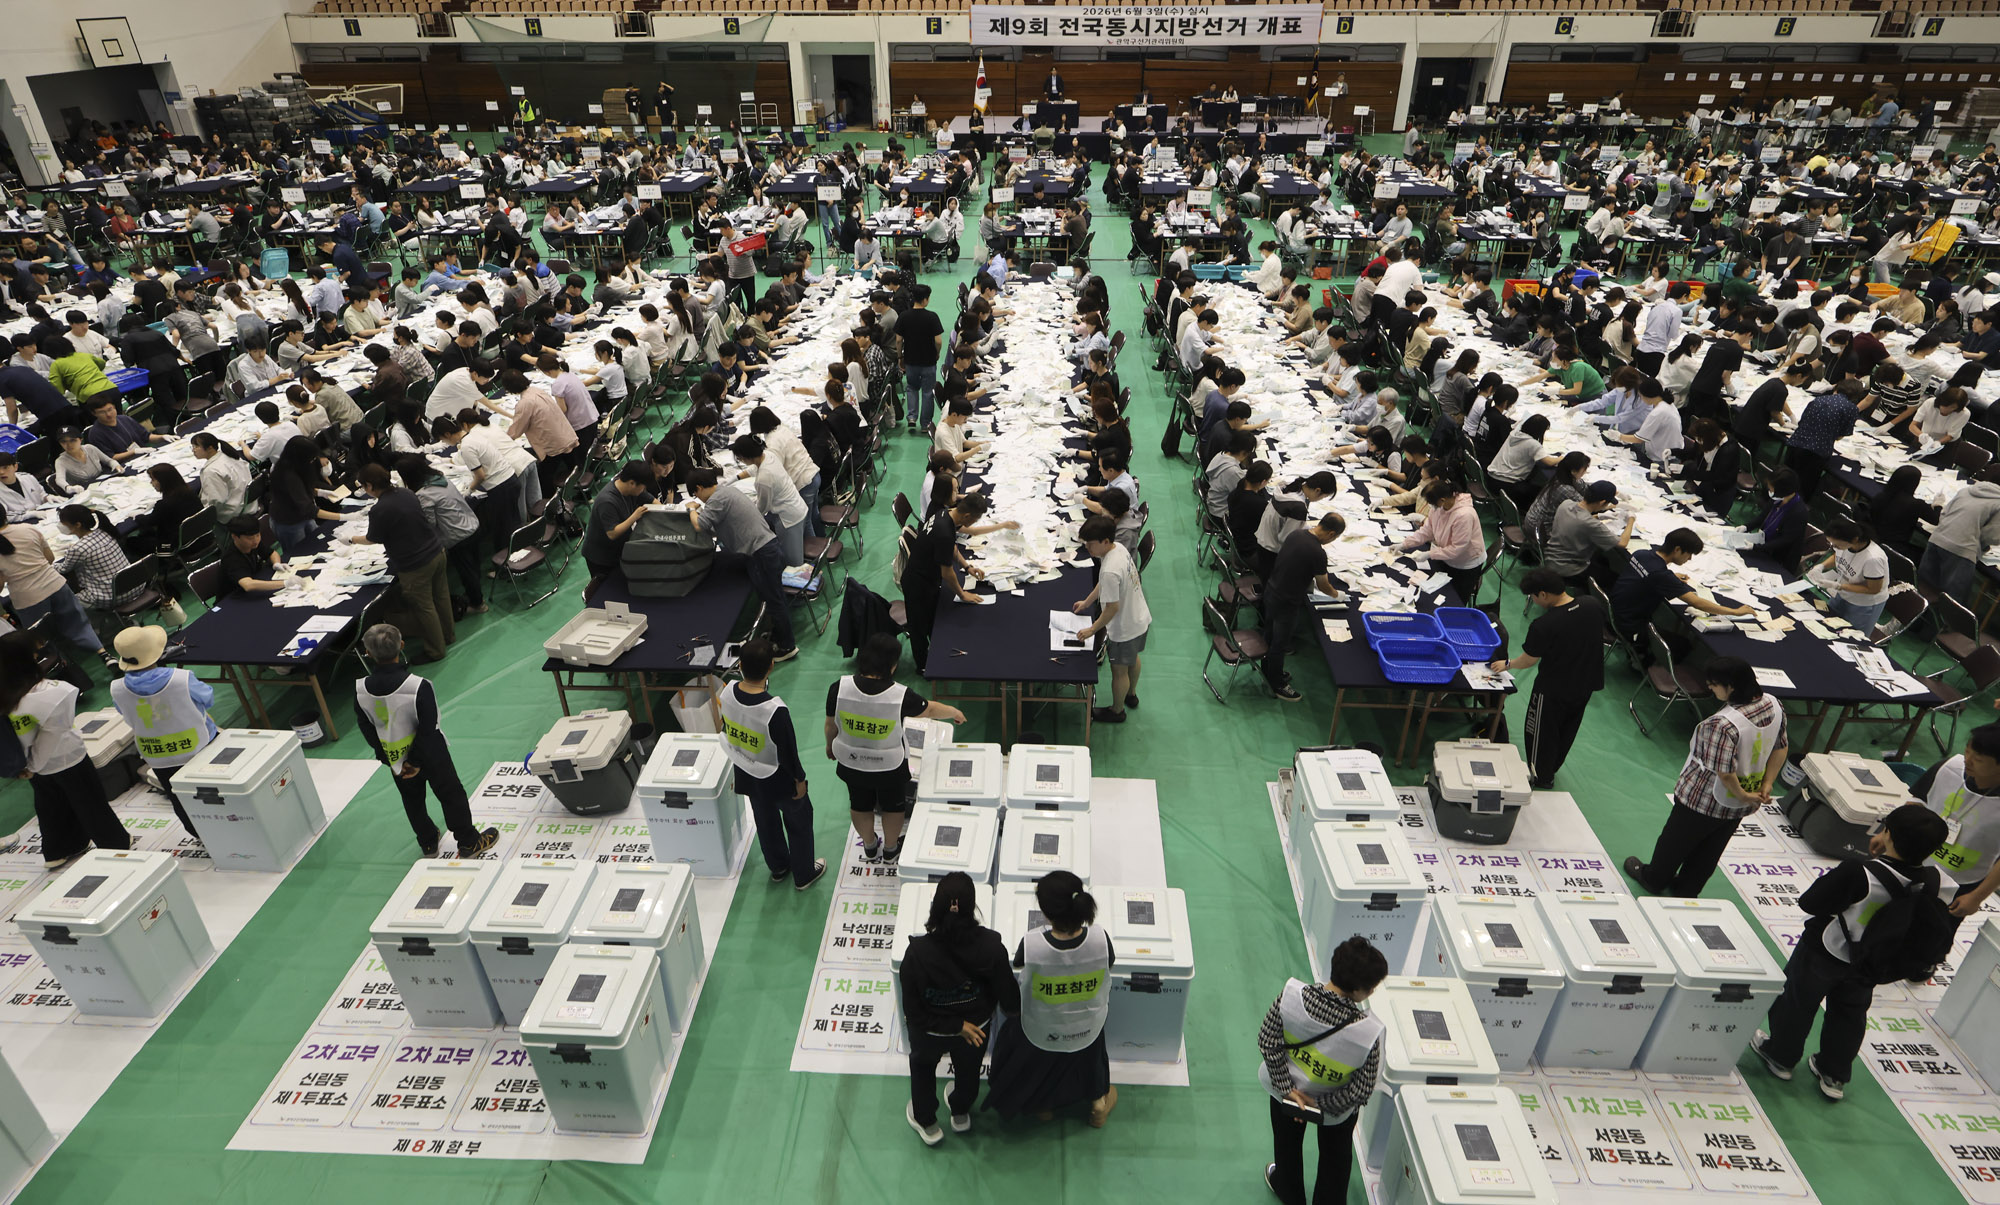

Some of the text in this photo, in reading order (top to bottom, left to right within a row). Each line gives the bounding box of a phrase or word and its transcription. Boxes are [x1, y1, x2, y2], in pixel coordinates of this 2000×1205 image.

[1083, 7, 1209, 16] 2026년 6월 3일(수) 실시
[528, 22, 539, 34] H
[727, 22, 737, 33] G
[931, 22, 937, 33] F
[990, 16, 1302, 36] 제9회 전국동시지방선거 개표
[1340, 21, 1350, 32] D
[1559, 21, 1569, 33] C
[1780, 22, 1790, 34] B
[1926, 22, 1936, 34] A
[845, 718, 888, 734] 개표참관
[142, 738, 192, 755] 개표참관
[496, 766, 536, 776] 관내
[482, 784, 542, 798] 은천동
[536, 824, 593, 835] 1차 교부
[612, 826, 635, 836] 1차
[535, 842, 573, 851] 삼성동
[612, 844, 650, 853] 삼성동
[1456, 855, 1521, 868] 2차 교부
[1934, 844, 1964, 868] 참관
[850, 866, 898, 877] 제1투표
[1538, 858, 1605, 871] 2차 교부
[1729, 864, 1797, 877] 2차 교부
[1480, 874, 1518, 884] 서원동
[1564, 877, 1603, 888] 서원동
[1757, 884, 1800, 895] 조원동
[842, 902, 869, 915] 1차
[1754, 896, 1800, 907] 제1투
[843, 923, 895, 935] 낙성대동
[824, 978, 891, 995] 1차 교부
[1039, 978, 1098, 996] 개표참관
[337, 998, 405, 1011] 제1투표소
[830, 1003, 874, 1017] 신원동
[813, 1019, 884, 1035] 제1투표소
[1880, 1017, 1924, 1033] 교부
[301, 1044, 380, 1062] 2차 교부
[396, 1046, 474, 1065] 2차 교부
[1871, 1042, 1939, 1057] 보라매동
[492, 1050, 527, 1067] 2차
[1878, 1059, 1962, 1075] 제1투표소
[299, 1072, 349, 1087] 신림동
[396, 1075, 446, 1090] 신림동
[494, 1078, 541, 1094] 신림동
[272, 1091, 348, 1106] 제1투표소
[371, 1094, 447, 1109] 제2투표소
[471, 1097, 546, 1113] 제3투표소
[1519, 1094, 1541, 1111] 부
[1563, 1096, 1647, 1117] 1차 교부
[1668, 1102, 1754, 1123] 1차 교부
[1917, 1113, 1961, 1131] 1차
[1595, 1128, 1646, 1144] 서원동
[1704, 1133, 1756, 1151] 서원동
[1586, 1147, 1674, 1166] 제3투표소
[1949, 1144, 2000, 1161] 보라매
[1696, 1153, 1786, 1173] 제4투표소
[1958, 1165, 2000, 1182] 제5투
